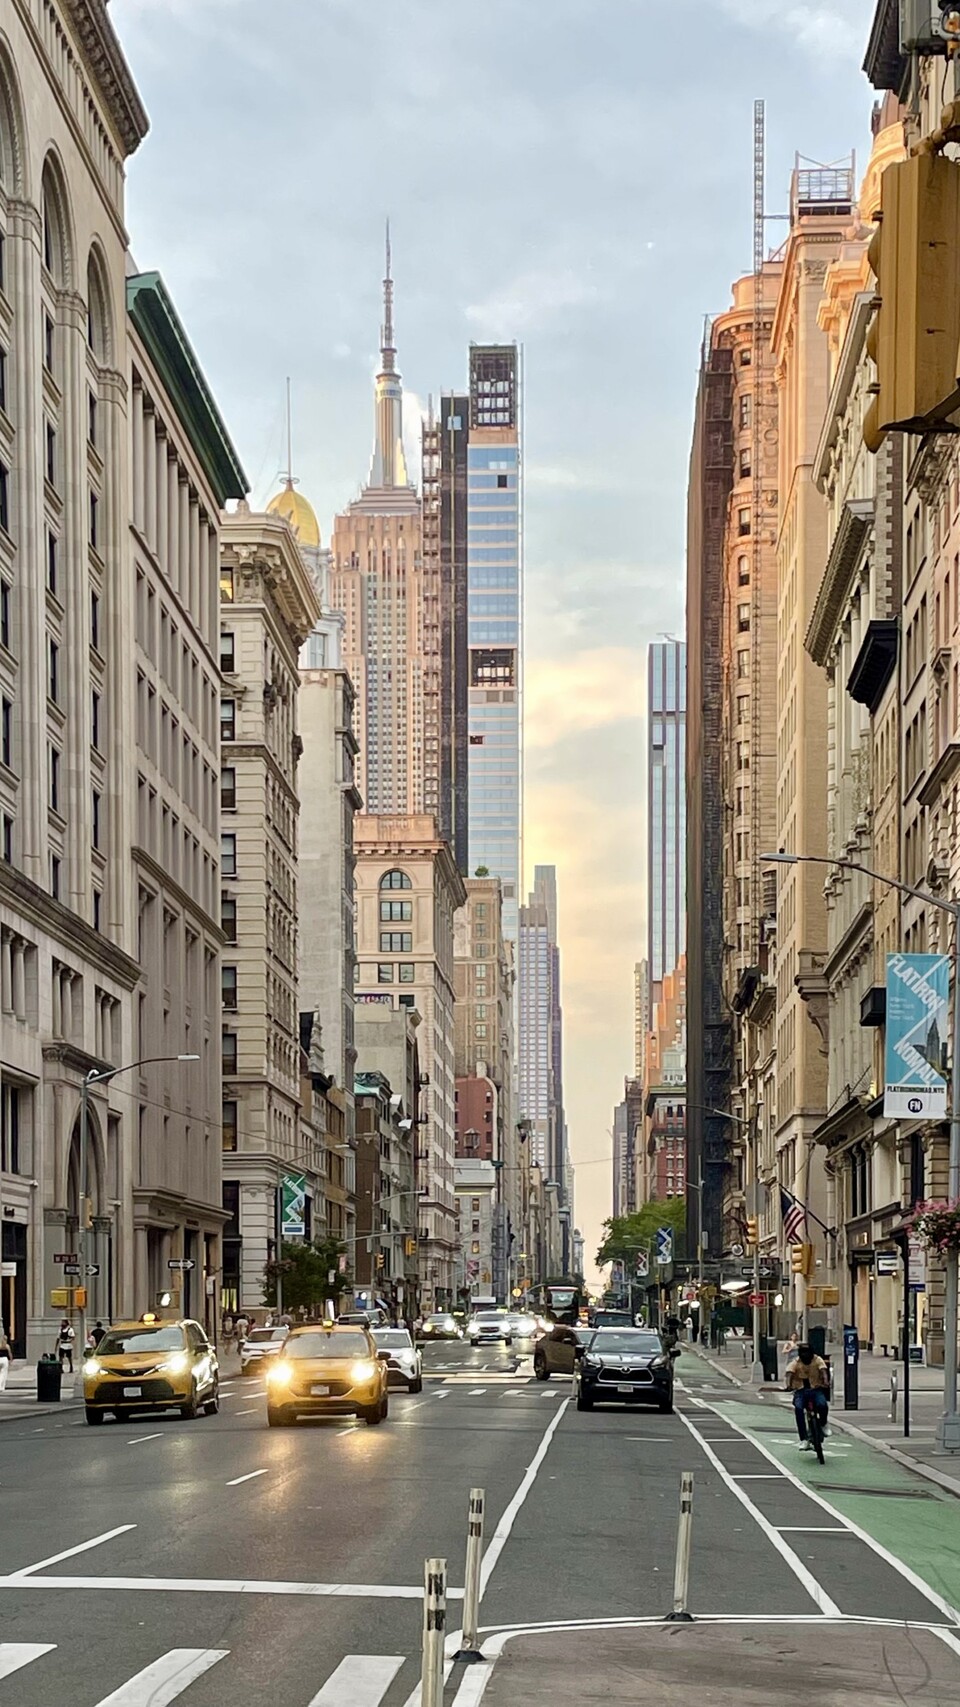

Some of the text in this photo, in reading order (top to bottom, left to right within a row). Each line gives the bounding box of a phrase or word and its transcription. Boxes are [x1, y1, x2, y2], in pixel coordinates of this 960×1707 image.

[887, 955, 945, 1011] FLATIRON
[893, 1040, 938, 1084] NOMAD
[848, 1335, 854, 1344] P
